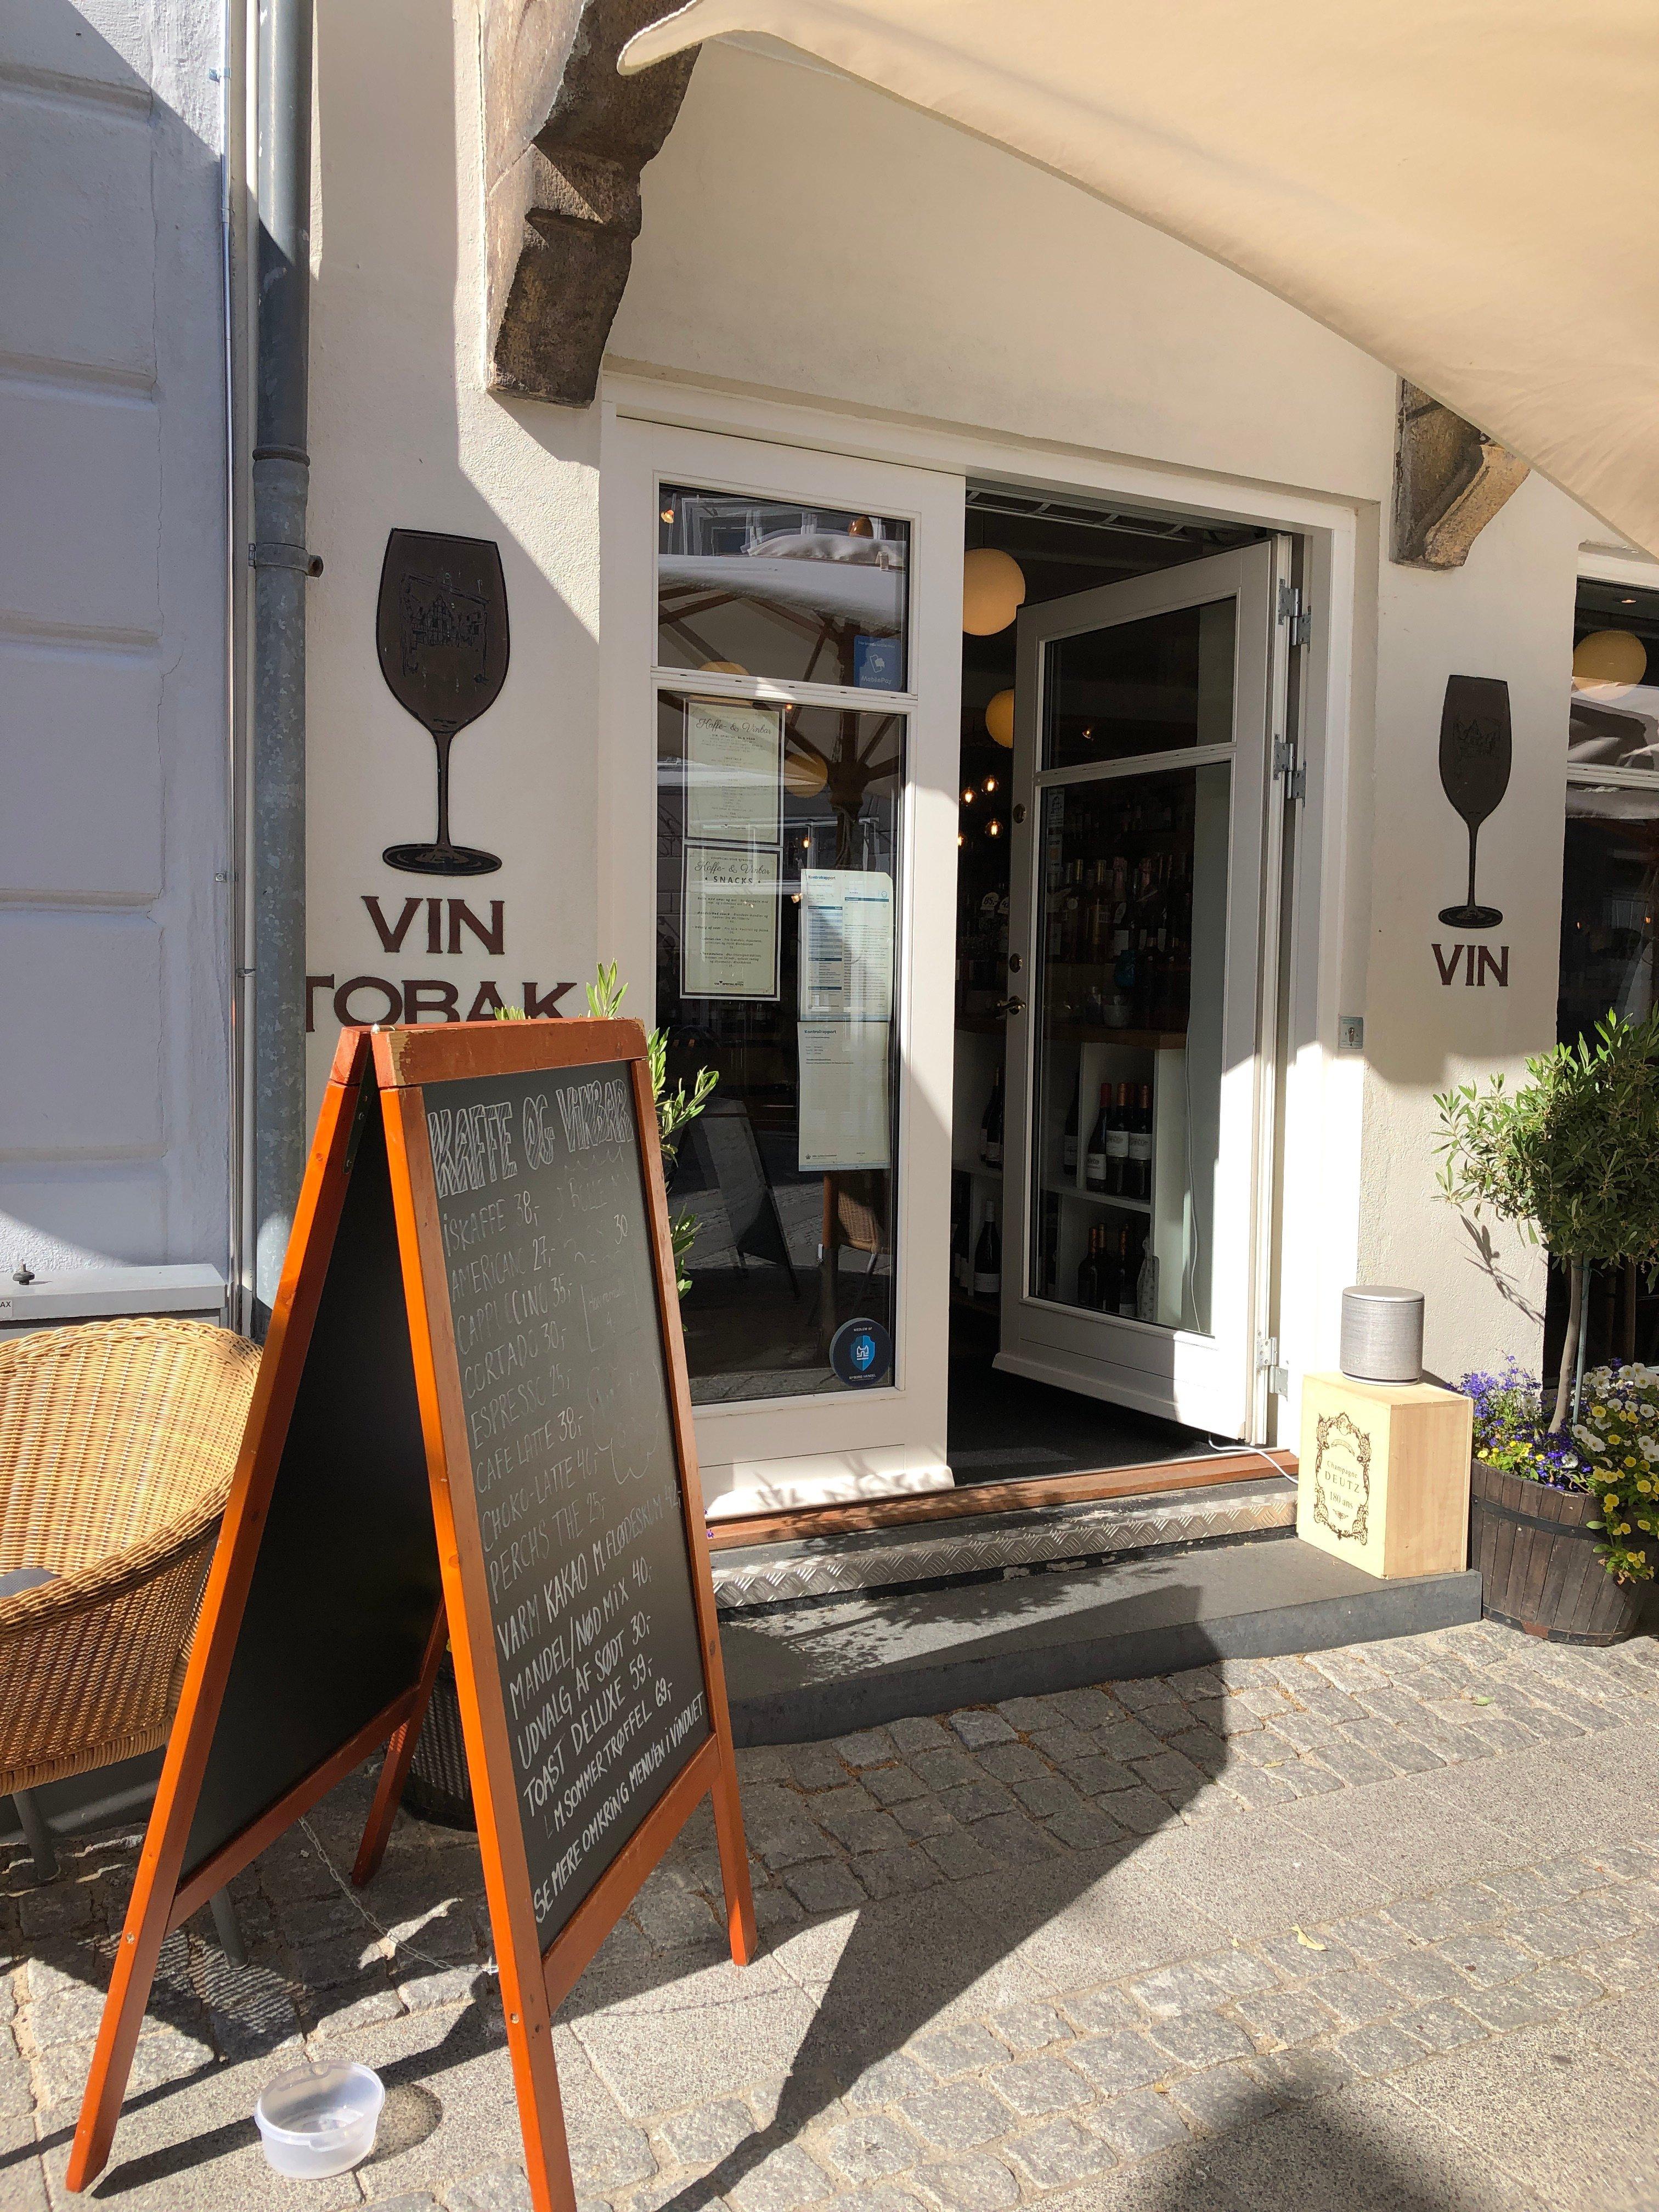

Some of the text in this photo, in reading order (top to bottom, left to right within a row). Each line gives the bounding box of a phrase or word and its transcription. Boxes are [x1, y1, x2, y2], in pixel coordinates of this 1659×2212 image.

[861, 675, 892, 685] MobilePay
[742, 722, 772, 735] Vinbar
[713, 876, 753, 884] SNACKS
[729, 865, 737, 873] &
[741, 863, 771, 874] Vinbar
[360, 895, 505, 955] VIN
[1431, 943, 1510, 987] VIN
[306, 974, 578, 1032] TOBAK
[427, 1102, 518, 1199] KAFFE
[522, 1094, 556, 1171] OG
[516, 1420, 555, 1465] LATTE
[1324, 1470, 1359, 1493] DEUTZ
[1327, 1460, 1358, 1479] Champagne
[1330, 1491, 1353, 1509] 180 ans
[551, 1499, 584, 1547] THE
[496, 1593, 541, 1662] VARM
[543, 1553, 588, 1624] KAKAO
[517, 1685, 573, 1770] UDVALG
[575, 1661, 591, 1702] AF
[595, 1627, 625, 1683] SØDT
[523, 1733, 566, 1818] TOAST
[571, 1675, 627, 1756] DELUXE
[533, 1879, 553, 1923] SE
[551, 1839, 583, 1897] MERE
